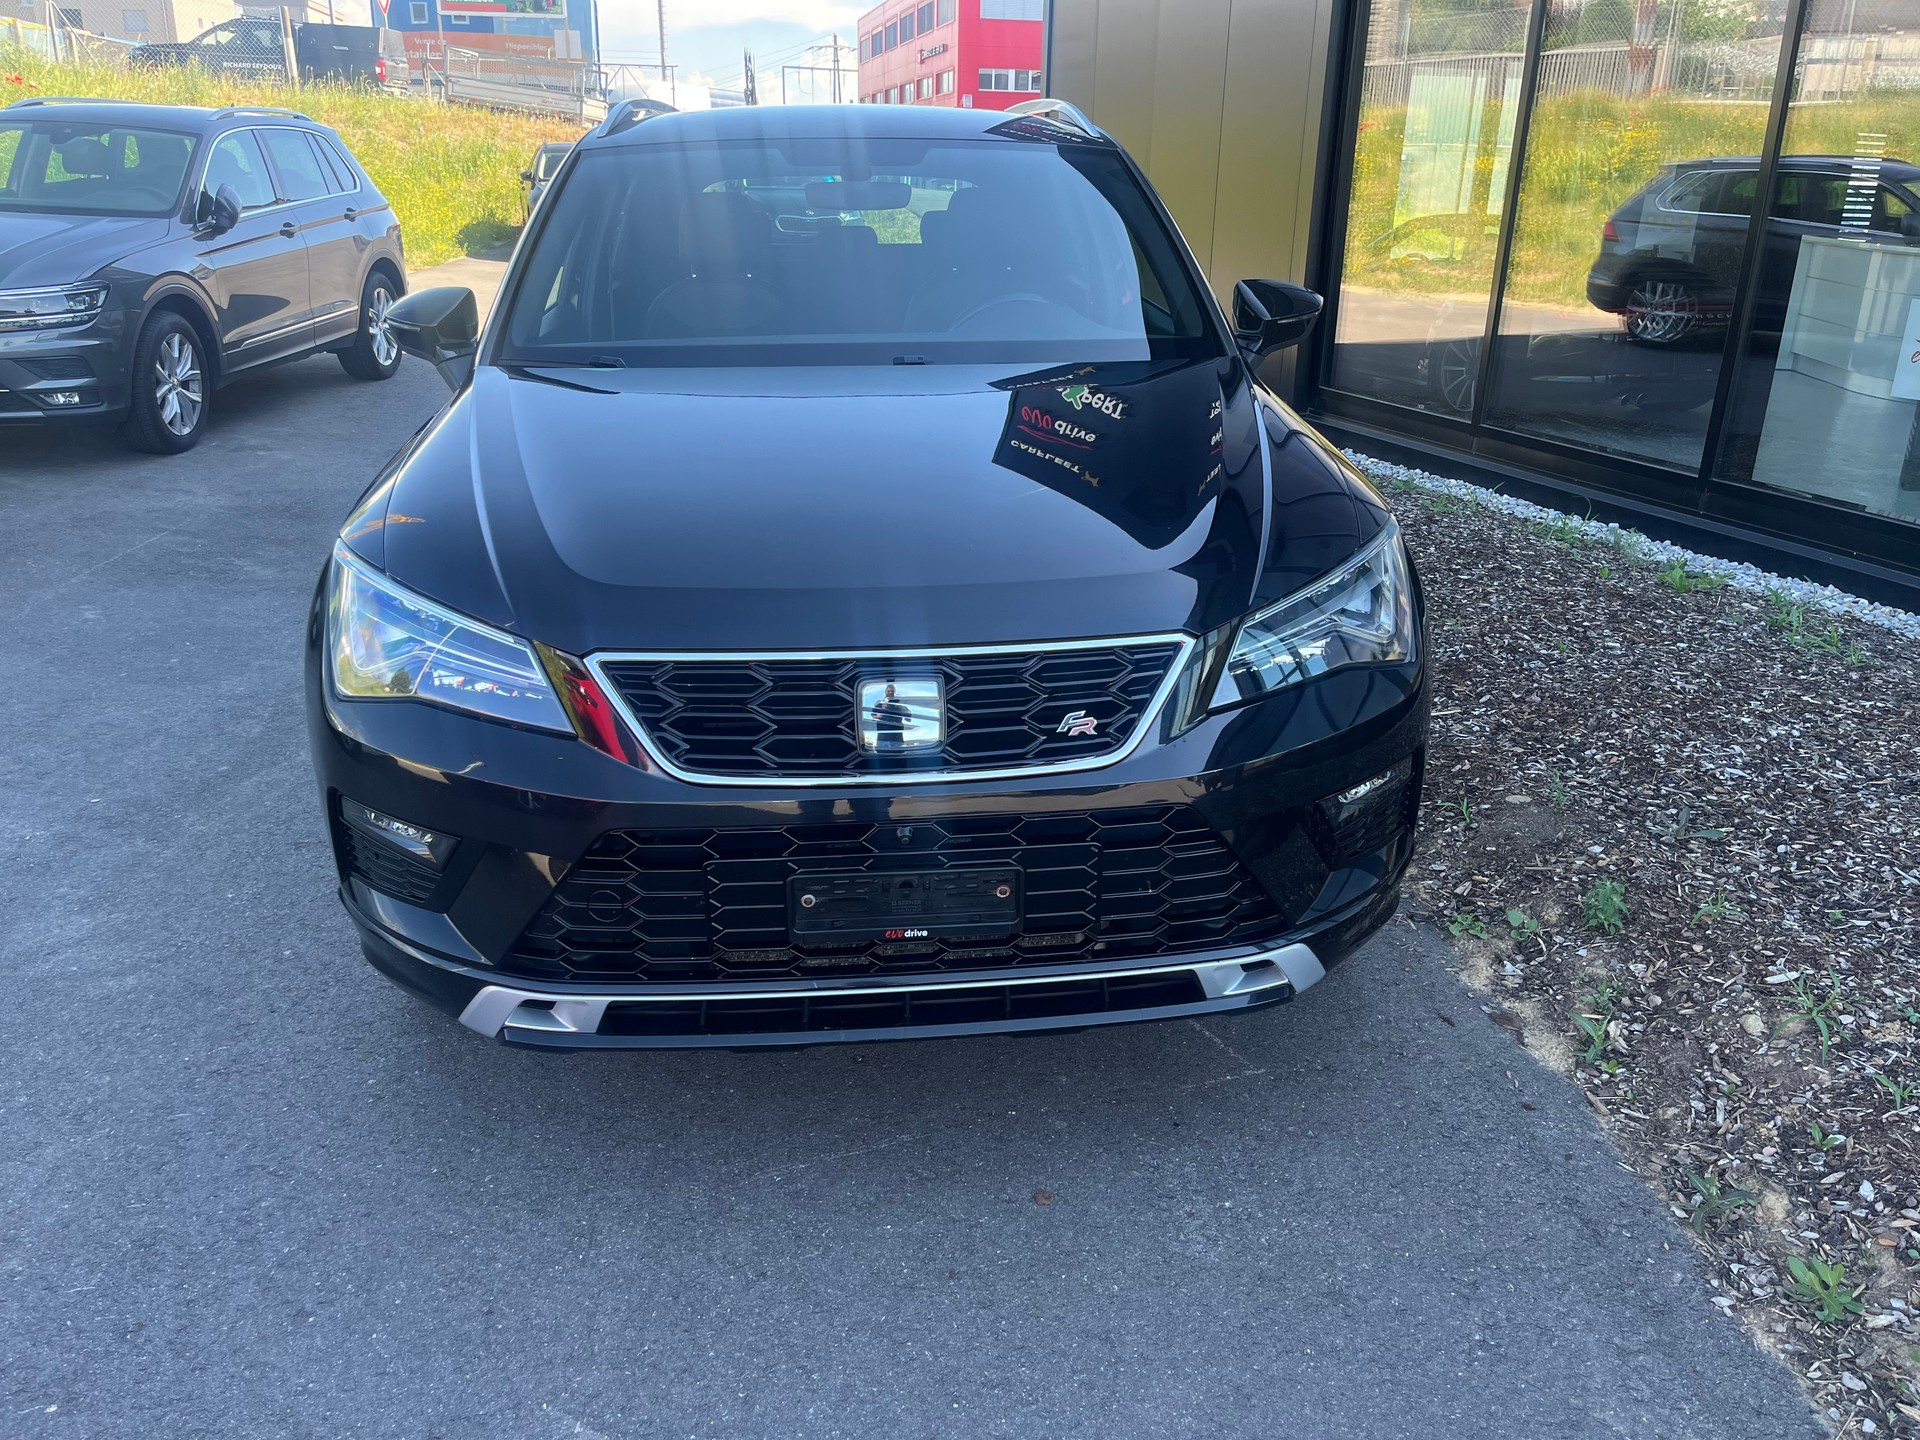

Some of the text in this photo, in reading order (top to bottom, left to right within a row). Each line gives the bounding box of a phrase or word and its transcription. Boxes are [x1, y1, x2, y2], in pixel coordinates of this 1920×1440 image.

[414, 37, 436, 45] Vente
[223, 61, 283, 71] RICHARD SEYDOUX
[1056, 710, 1098, 737] FR
